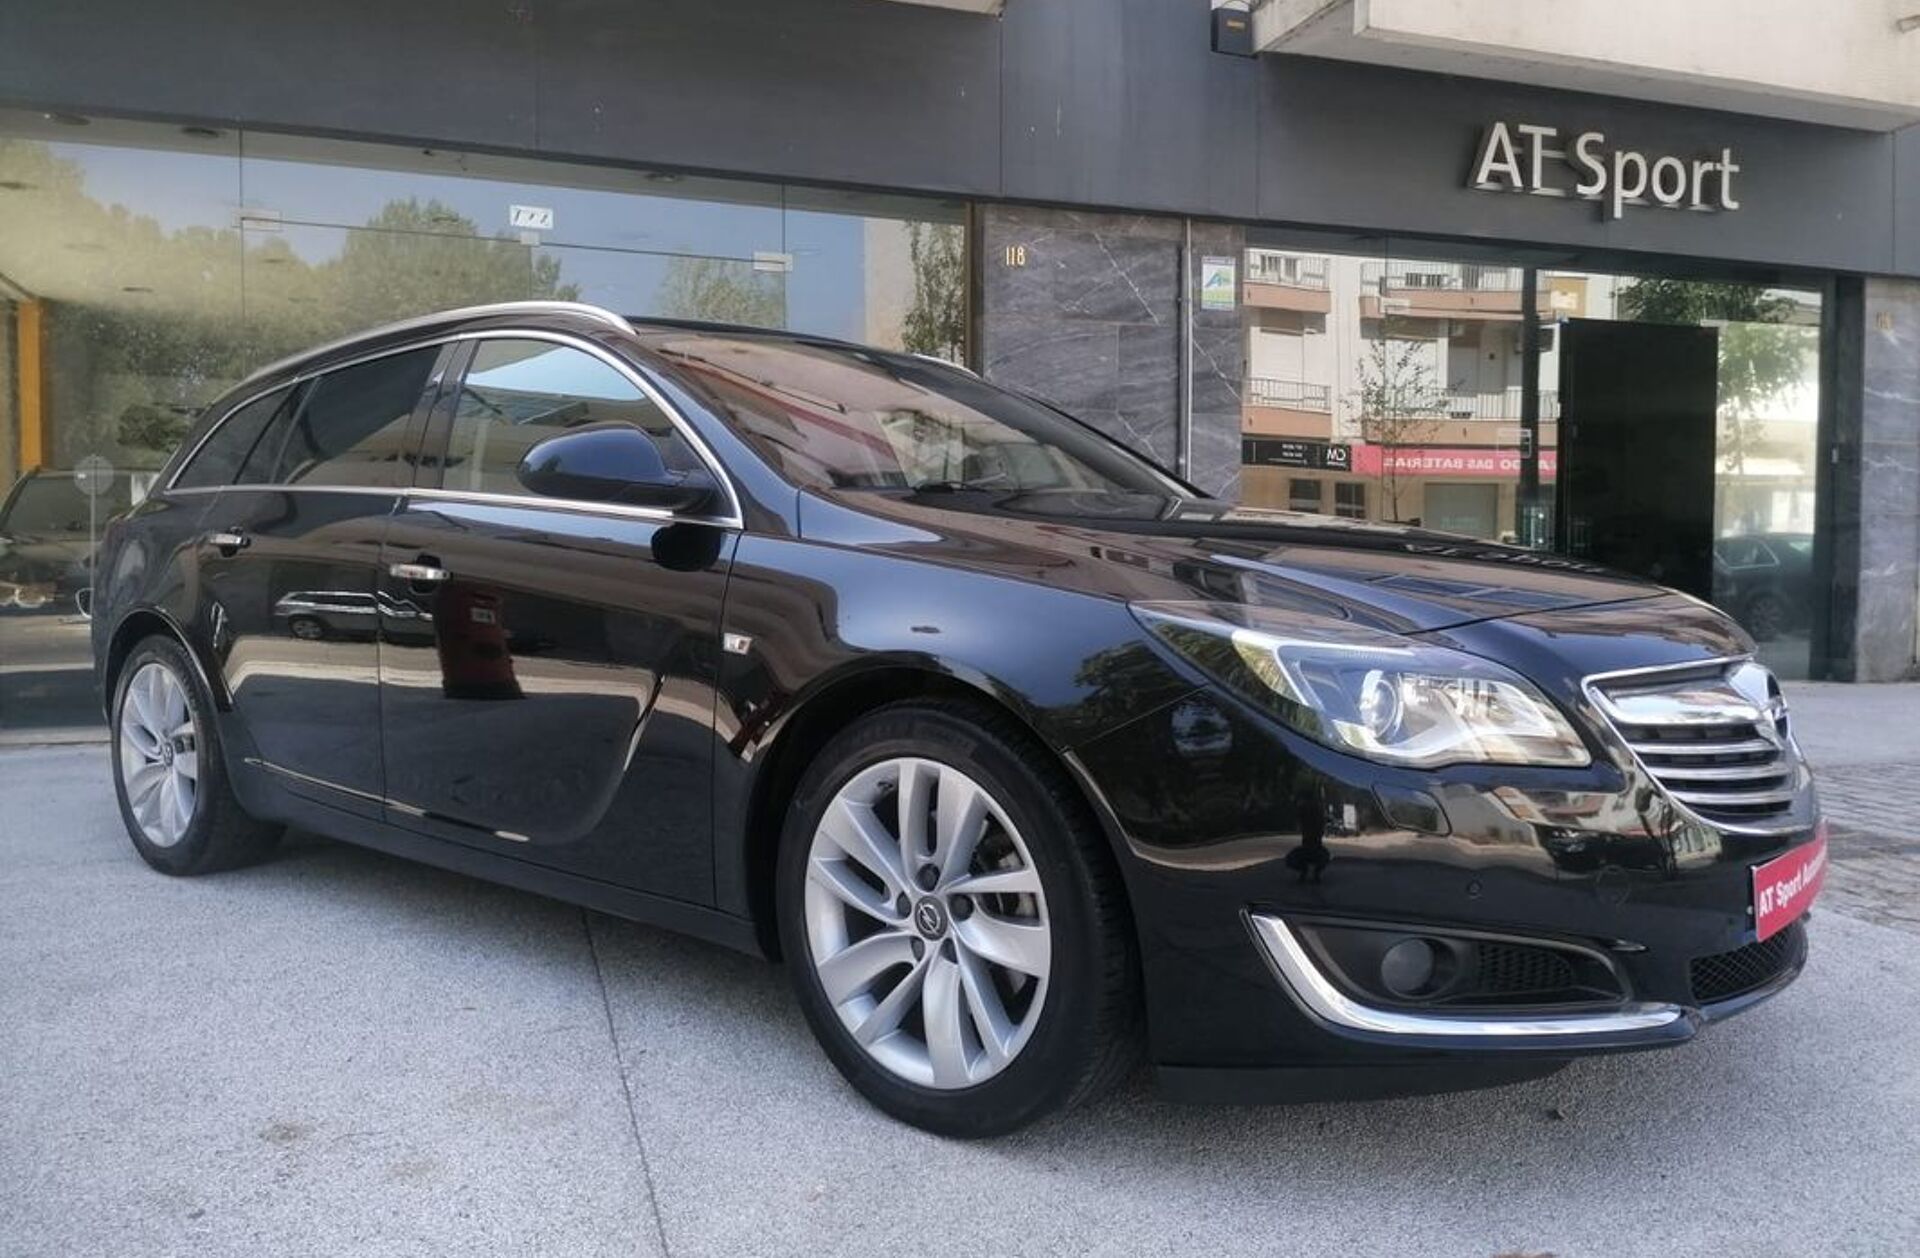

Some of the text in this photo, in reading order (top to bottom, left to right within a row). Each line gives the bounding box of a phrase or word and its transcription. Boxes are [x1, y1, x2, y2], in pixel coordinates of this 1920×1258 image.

[1475, 121, 1740, 219] AT Sport
[1006, 246, 1025, 266] 118
[1760, 868, 1802, 917] AT Sport
